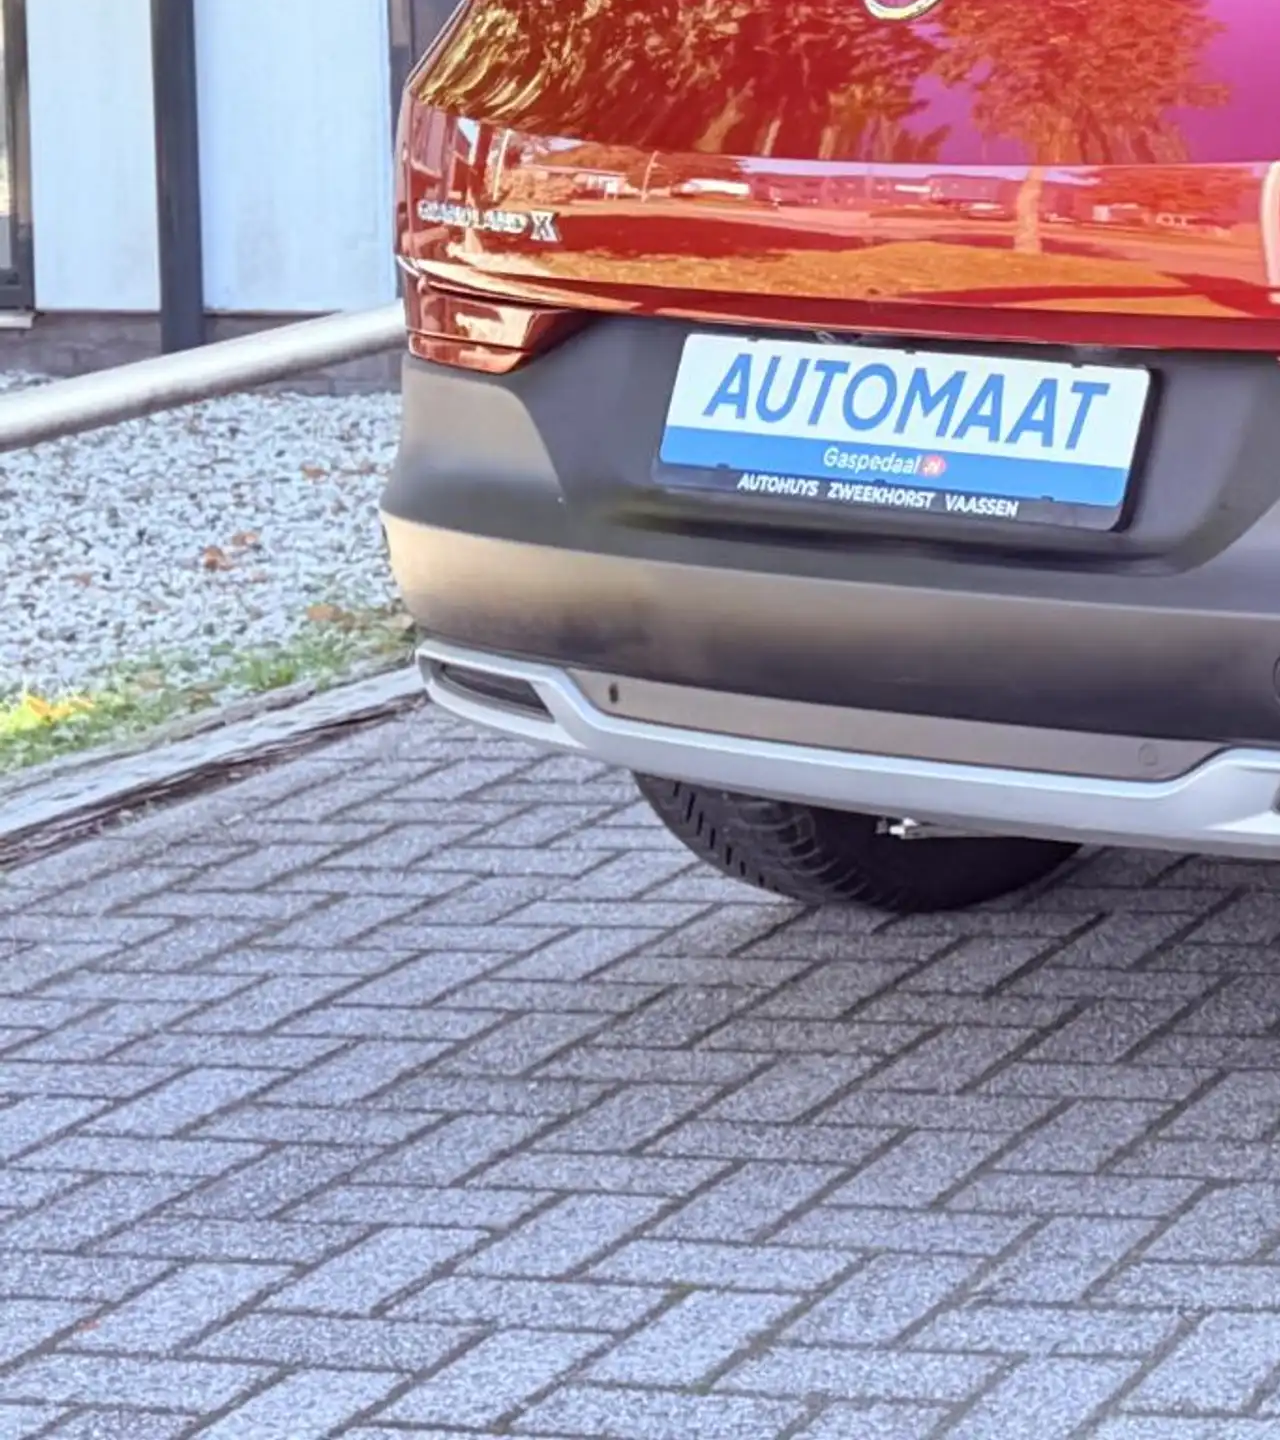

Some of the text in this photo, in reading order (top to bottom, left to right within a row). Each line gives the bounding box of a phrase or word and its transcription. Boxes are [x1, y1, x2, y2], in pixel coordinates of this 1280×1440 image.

[702, 352, 1111, 450] AUTOMAAT
[737, 472, 1020, 518] AUTOHUYS ZWEEKHORST VAASSEN
